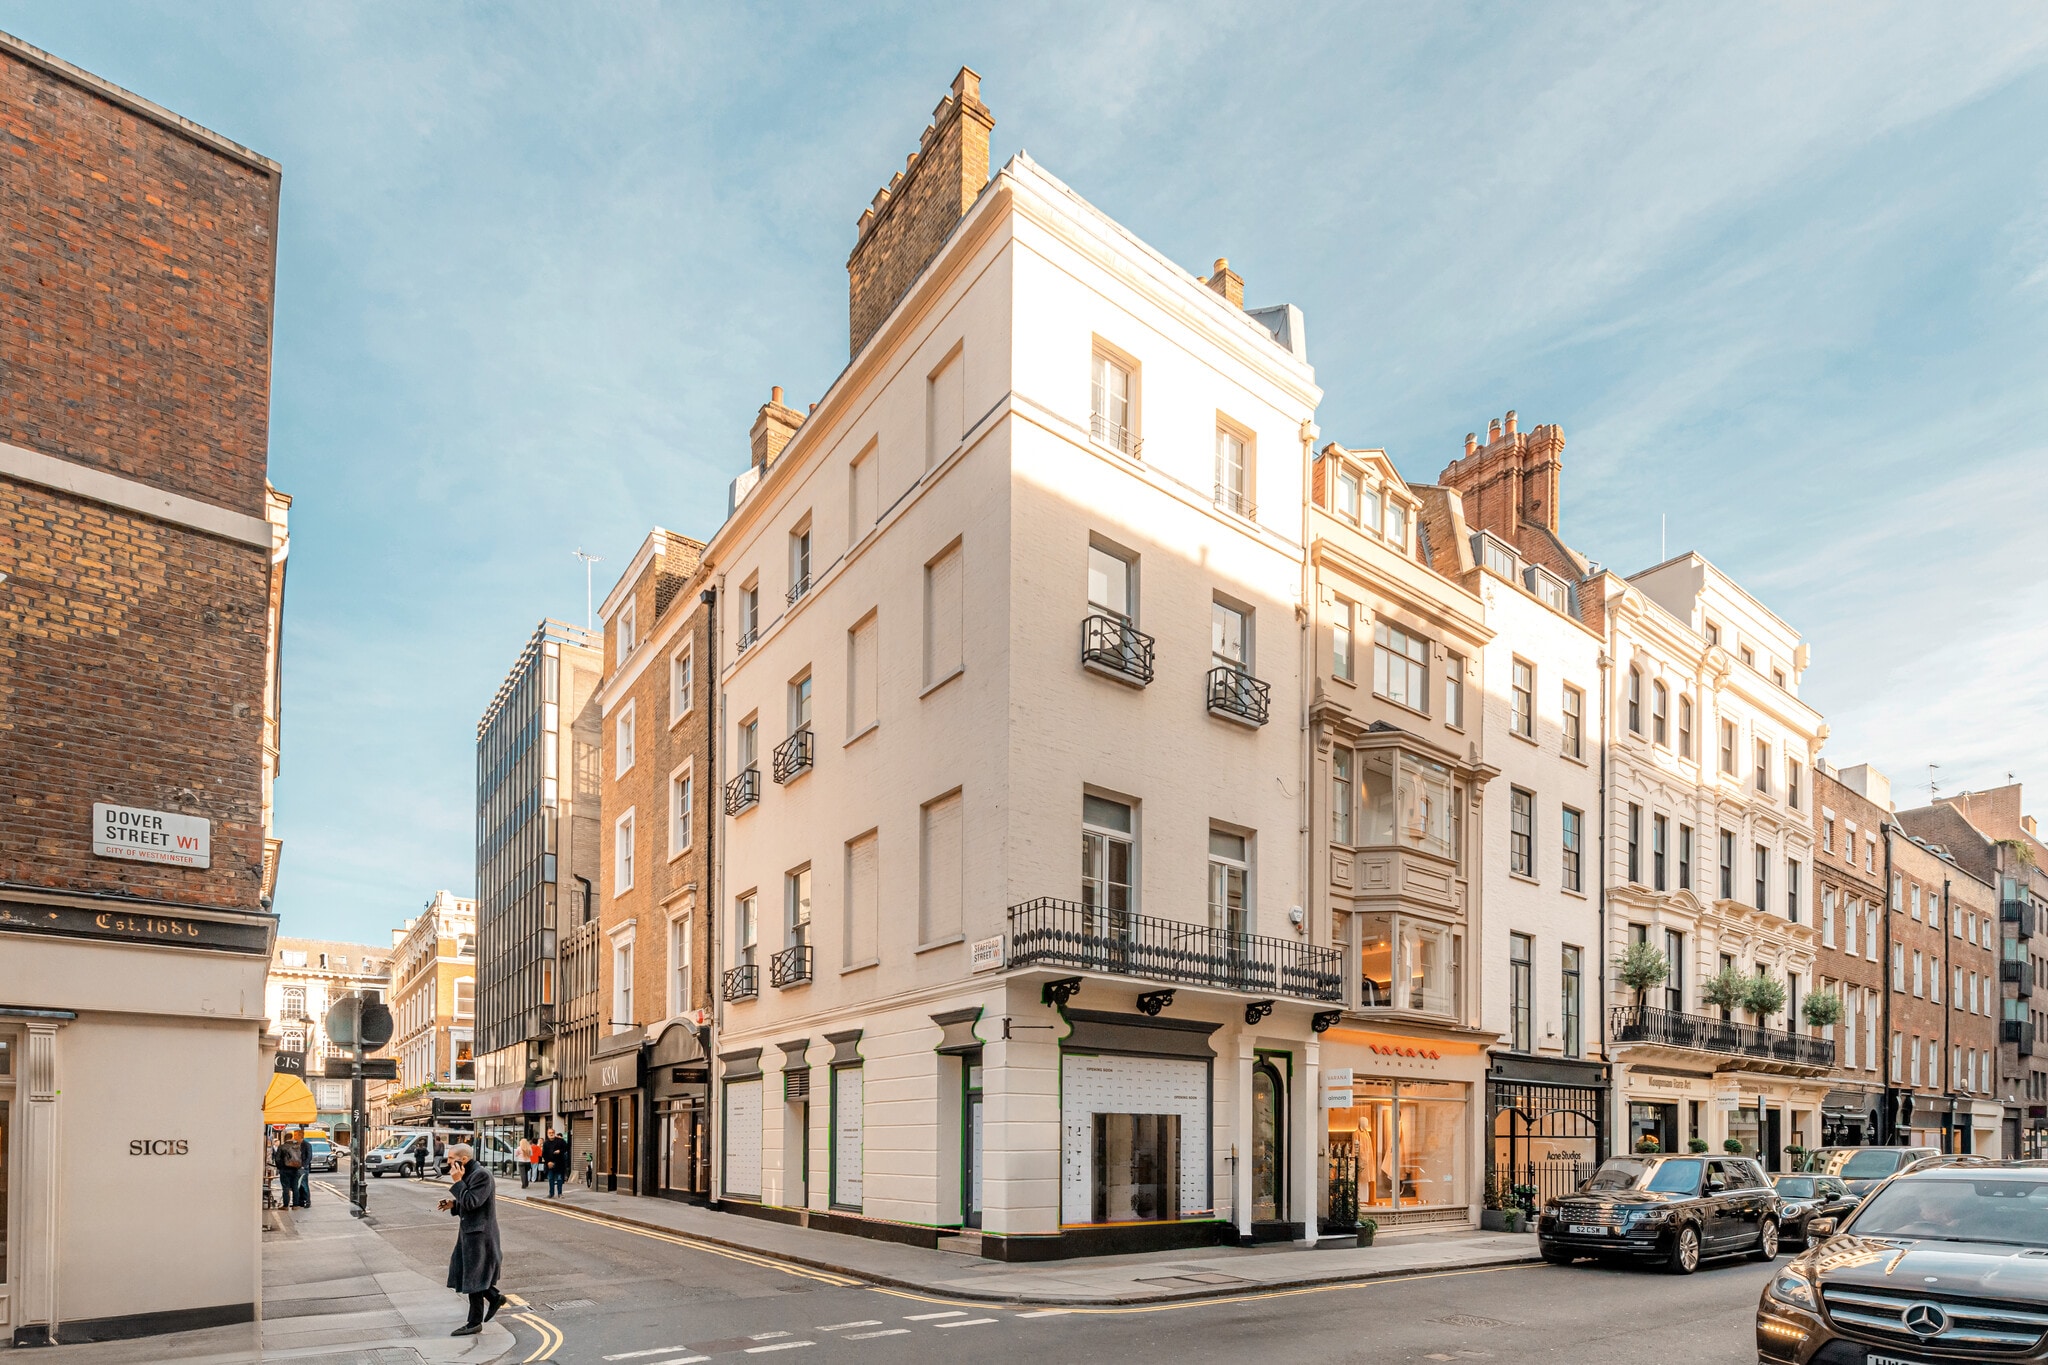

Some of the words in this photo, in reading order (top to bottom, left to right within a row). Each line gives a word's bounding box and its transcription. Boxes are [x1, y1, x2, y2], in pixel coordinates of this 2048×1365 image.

[106, 810, 162, 830] DOVER
[106, 826, 170, 846] STREET
[176, 835, 199, 851] W1
[106, 846, 124, 855] CITY
[126, 849, 136, 857] OF
[138, 851, 193, 864] WESTMINSTER
[974, 950, 992, 963] STREET
[602, 1065, 619, 1087] KSM
[129, 1139, 189, 1156] SICIS
[1547, 1151, 1561, 1160] Acne
[1561, 1150, 1581, 1160] Studios
